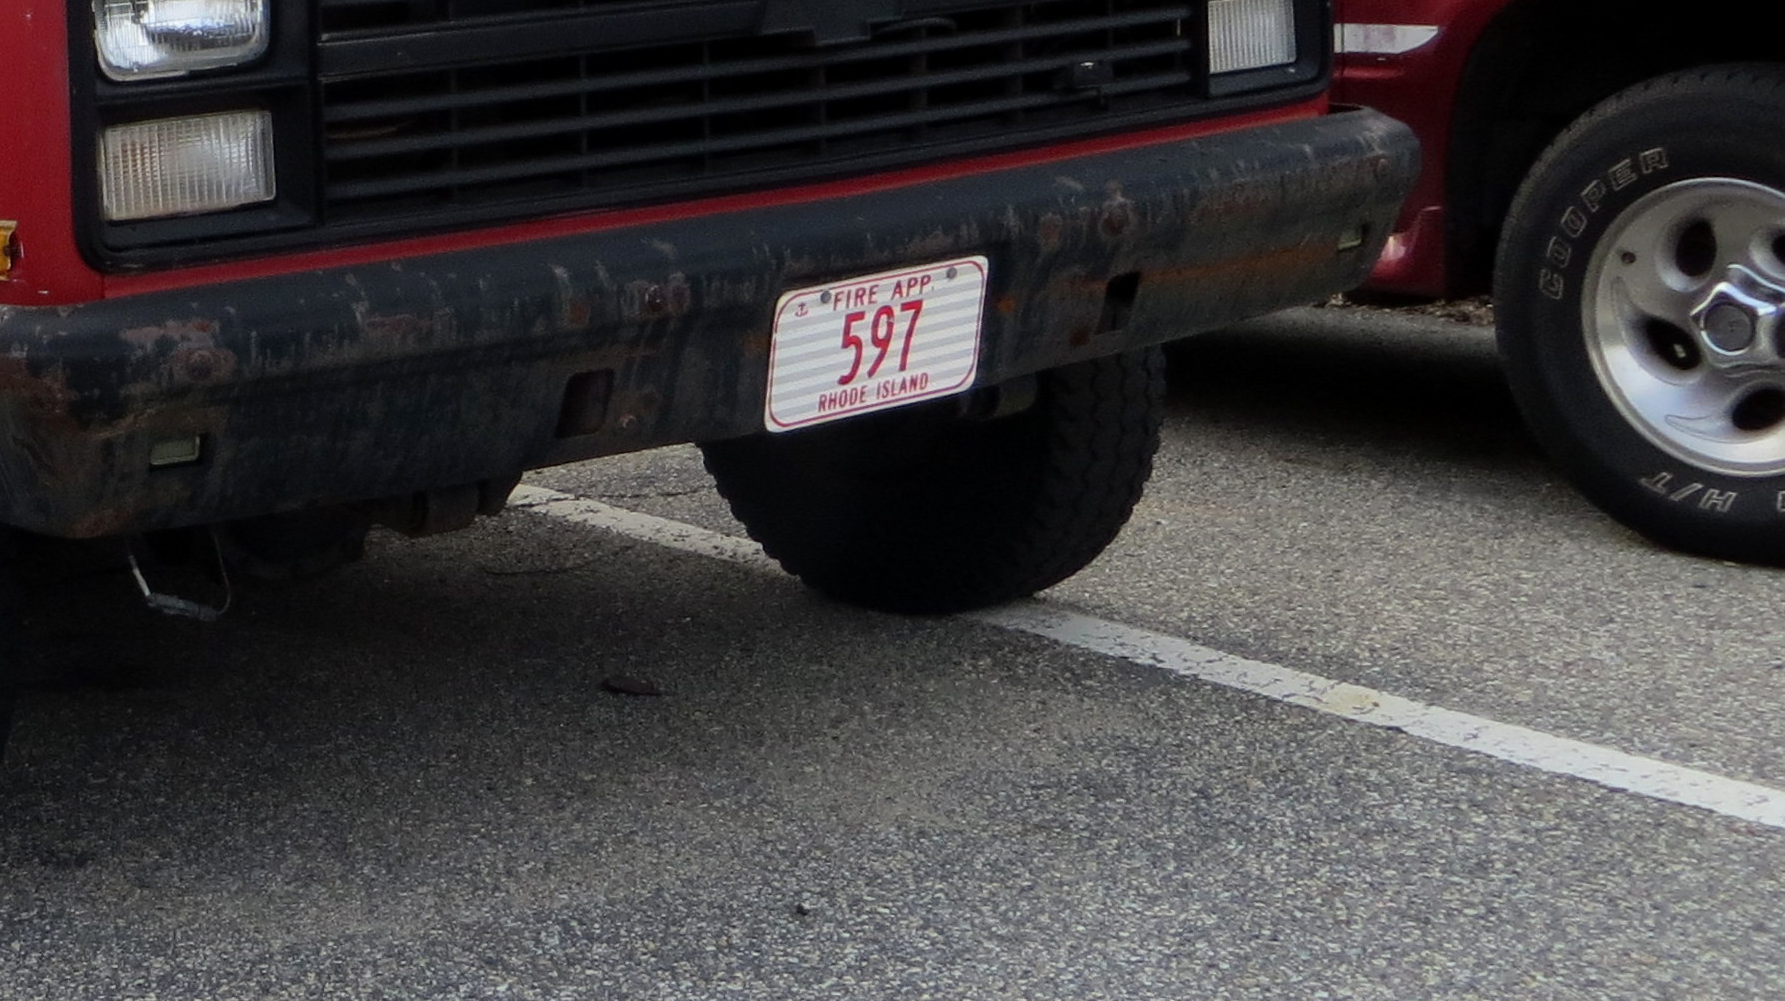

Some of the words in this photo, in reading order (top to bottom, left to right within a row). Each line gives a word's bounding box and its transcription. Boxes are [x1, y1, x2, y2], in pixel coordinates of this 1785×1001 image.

[1538, 146, 1671, 302] COOPER
[832, 284, 880, 311] FIRE
[837, 299, 924, 386] 597
[818, 385, 868, 412] RHODE
[876, 372, 930, 399] ISLAND
